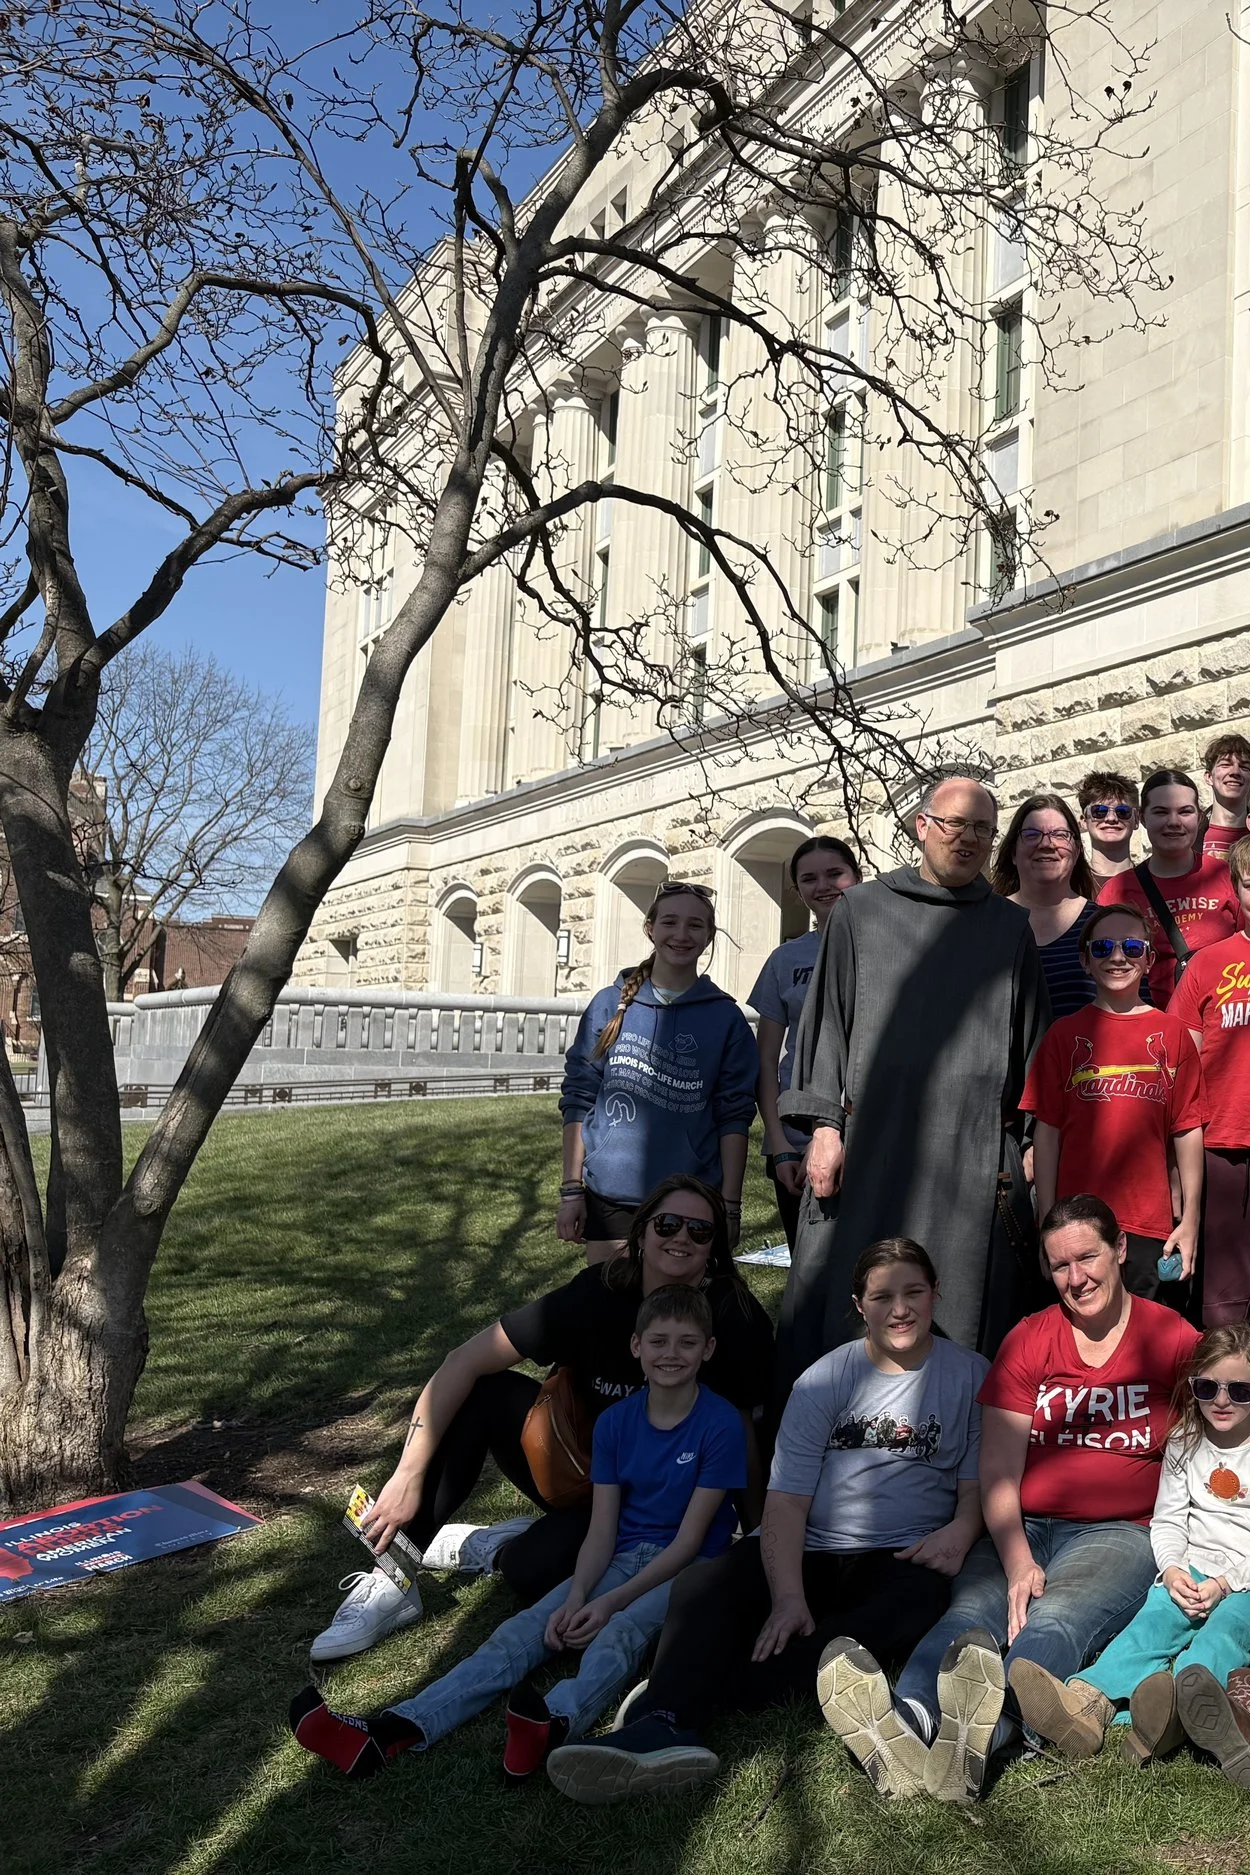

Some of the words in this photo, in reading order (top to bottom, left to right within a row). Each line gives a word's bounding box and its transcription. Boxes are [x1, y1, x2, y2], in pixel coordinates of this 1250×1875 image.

[1154, 912, 1203, 928] ADEMY
[621, 1031, 638, 1042] PRO
[614, 1043, 632, 1054] PRO
[638, 1060, 673, 1086] PRO-LIFE
[672, 1078, 704, 1091] MARCH
[4, 1521, 81, 1547] ILLINOIS
[17, 1504, 164, 1552] ABORTION
[36, 1527, 132, 1557] AMERICAN
[85, 1554, 133, 1571] MARCH
